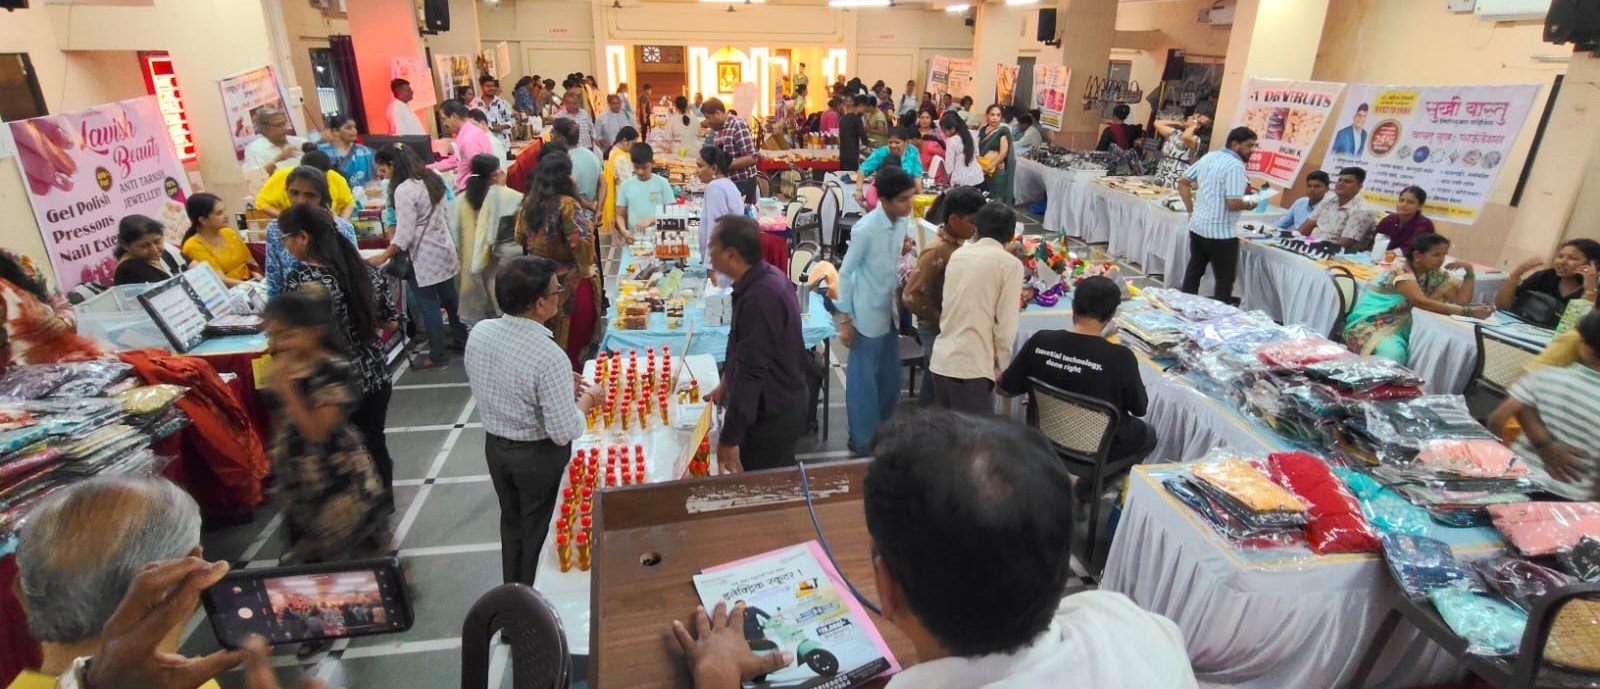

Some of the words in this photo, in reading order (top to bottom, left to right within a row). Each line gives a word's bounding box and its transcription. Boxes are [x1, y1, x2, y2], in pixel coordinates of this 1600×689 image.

[1426, 96, 1461, 123] सुखी
[1466, 102, 1510, 126] वास्तु
[80, 110, 135, 155] Lavish
[113, 136, 160, 179] Beauty
[120, 178, 138, 193] ANTI
[46, 204, 75, 224] Gel
[75, 192, 111, 216] Polish
[52, 214, 116, 245] Pressons
[59, 243, 93, 262] Nail
[1035, 347, 1063, 360] Essential
[1046, 359, 1063, 369] done
[1063, 364, 1082, 374] right
